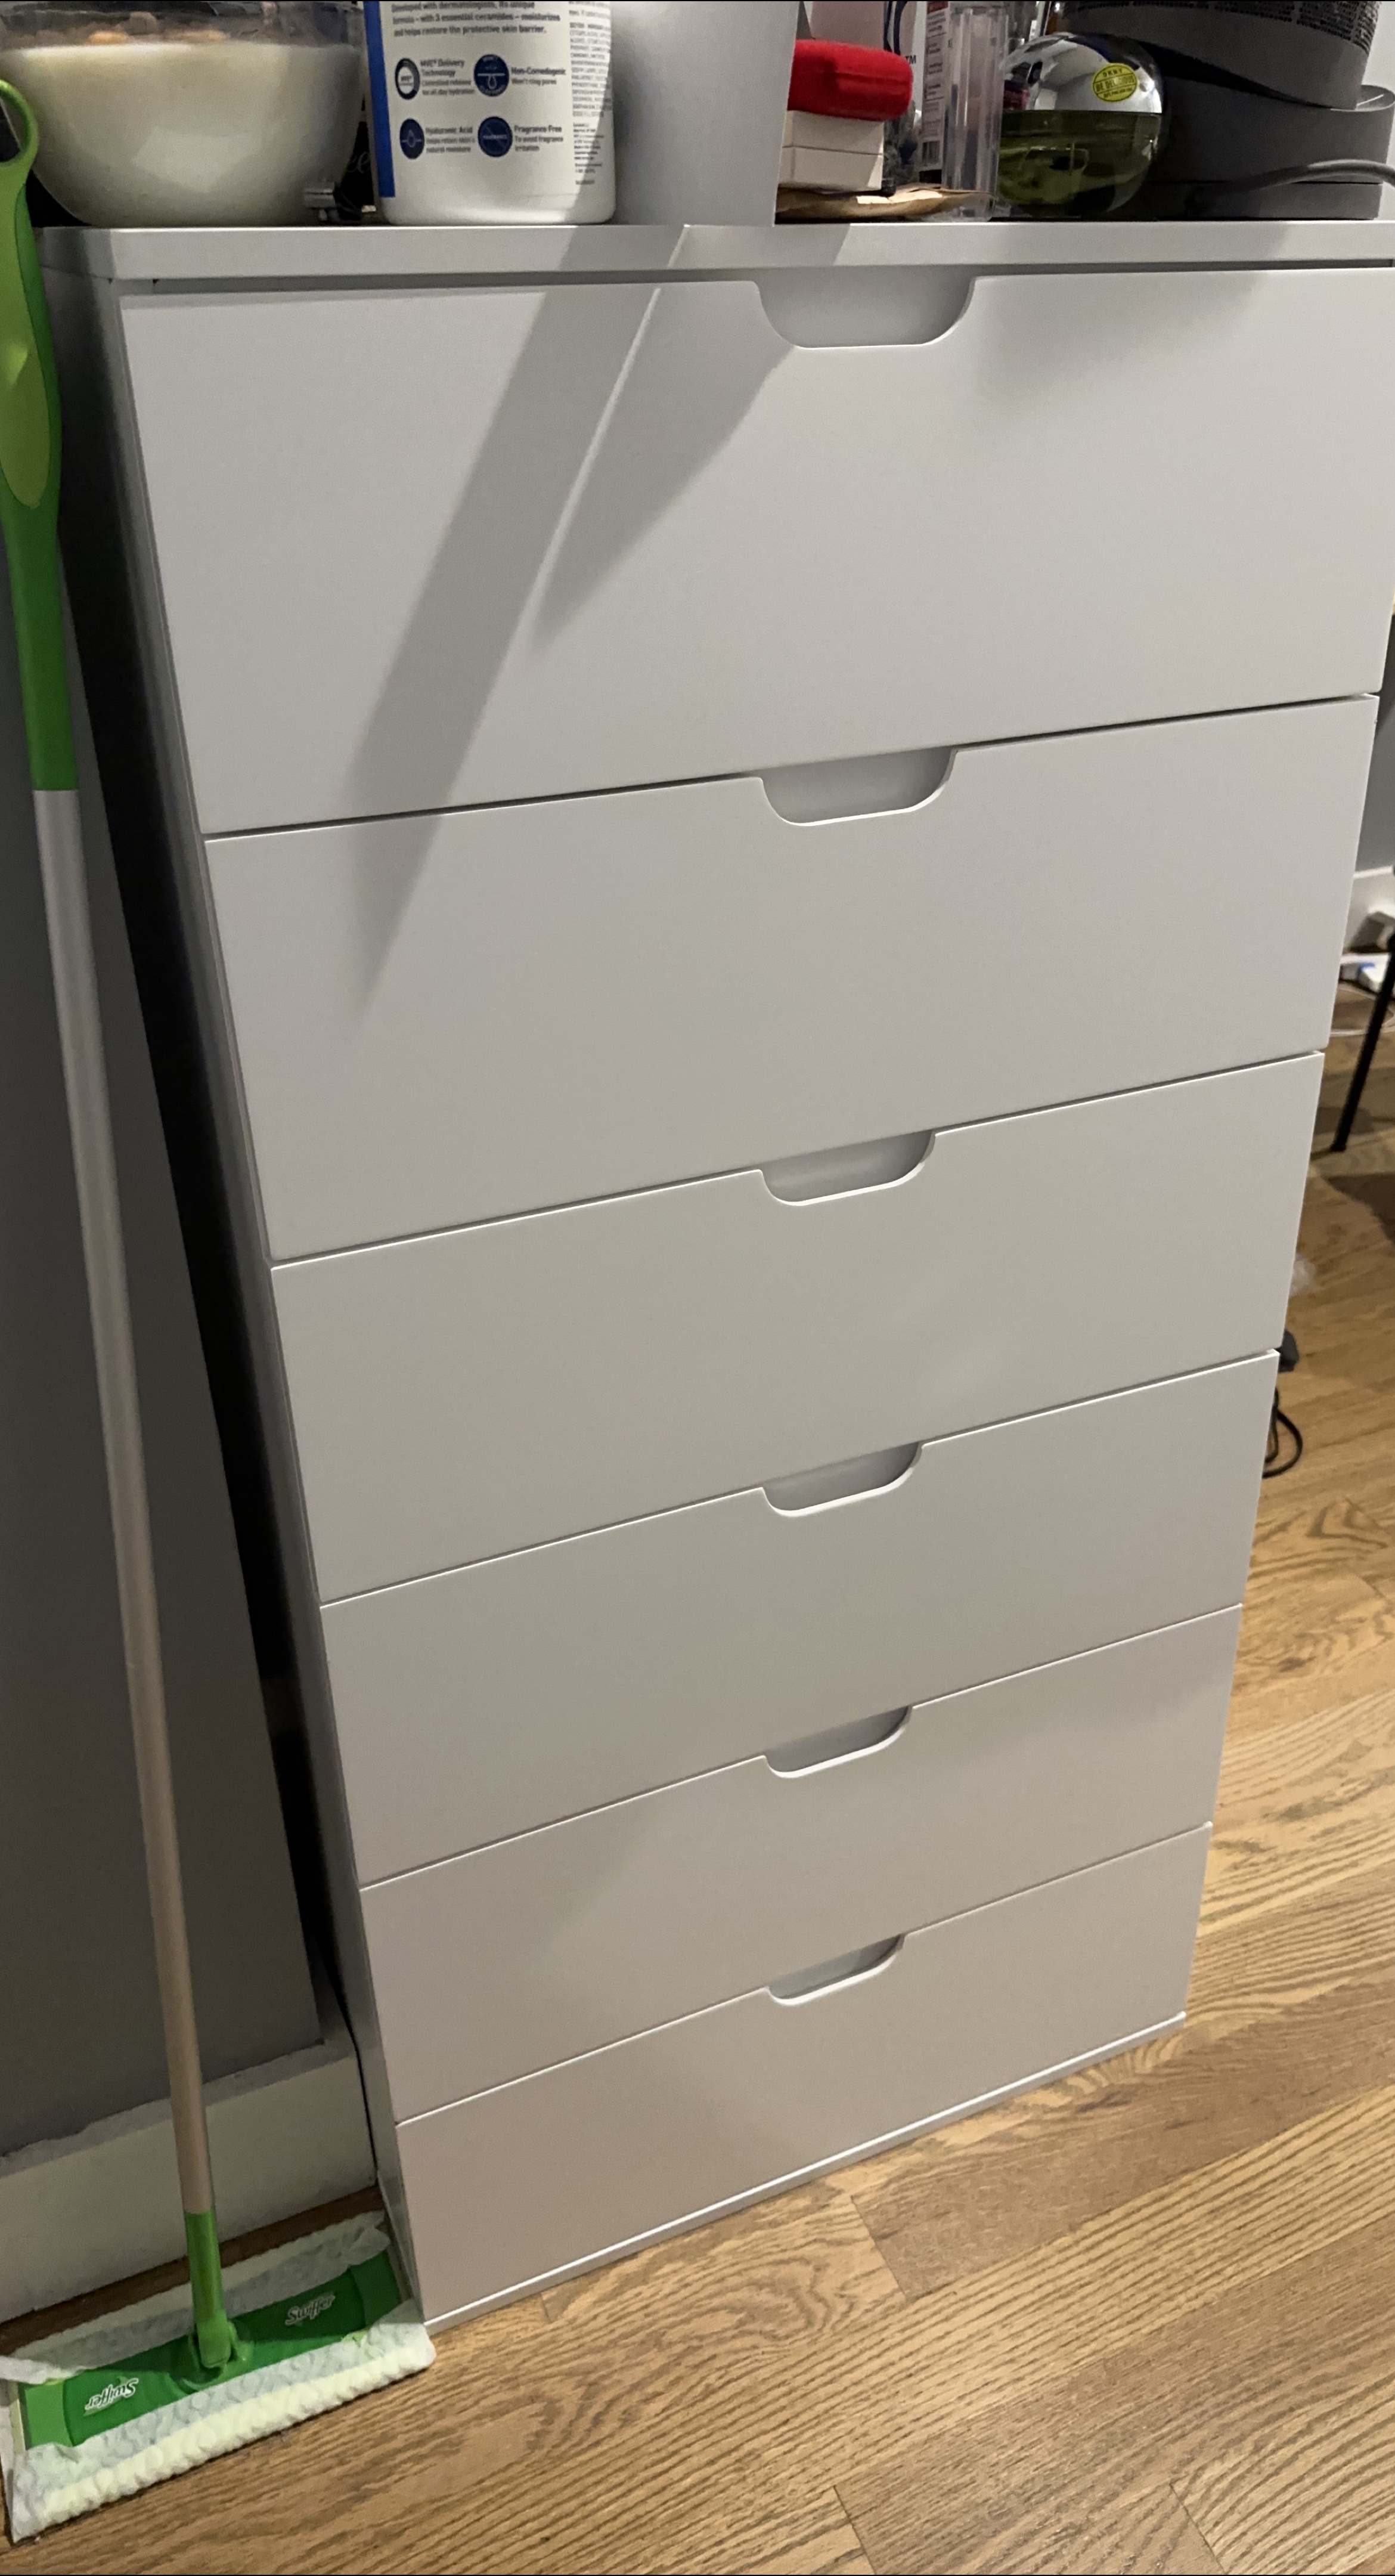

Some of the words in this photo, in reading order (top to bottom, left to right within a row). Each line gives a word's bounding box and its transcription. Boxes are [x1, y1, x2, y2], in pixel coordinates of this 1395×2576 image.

[435, 13, 440, 21] 3
[441, 13, 473, 21] essential
[475, 13, 513, 21] ceramides
[521, 13, 560, 21] moisturizes
[463, 25, 500, 35] protective
[501, 24, 517, 33] skin
[518, 24, 547, 33] barrier.
[438, 60, 464, 68] Delivery
[511, 66, 566, 76] Non-Comedogenic
[1102, 68, 1123, 78] DKNY
[514, 125, 547, 134] Fragrance
[548, 124, 562, 132] Free
[538, 135, 563, 144] fragrance
[285, 2293, 335, 2325] Swiffer
[85, 2377, 139, 2410] Swiffer
